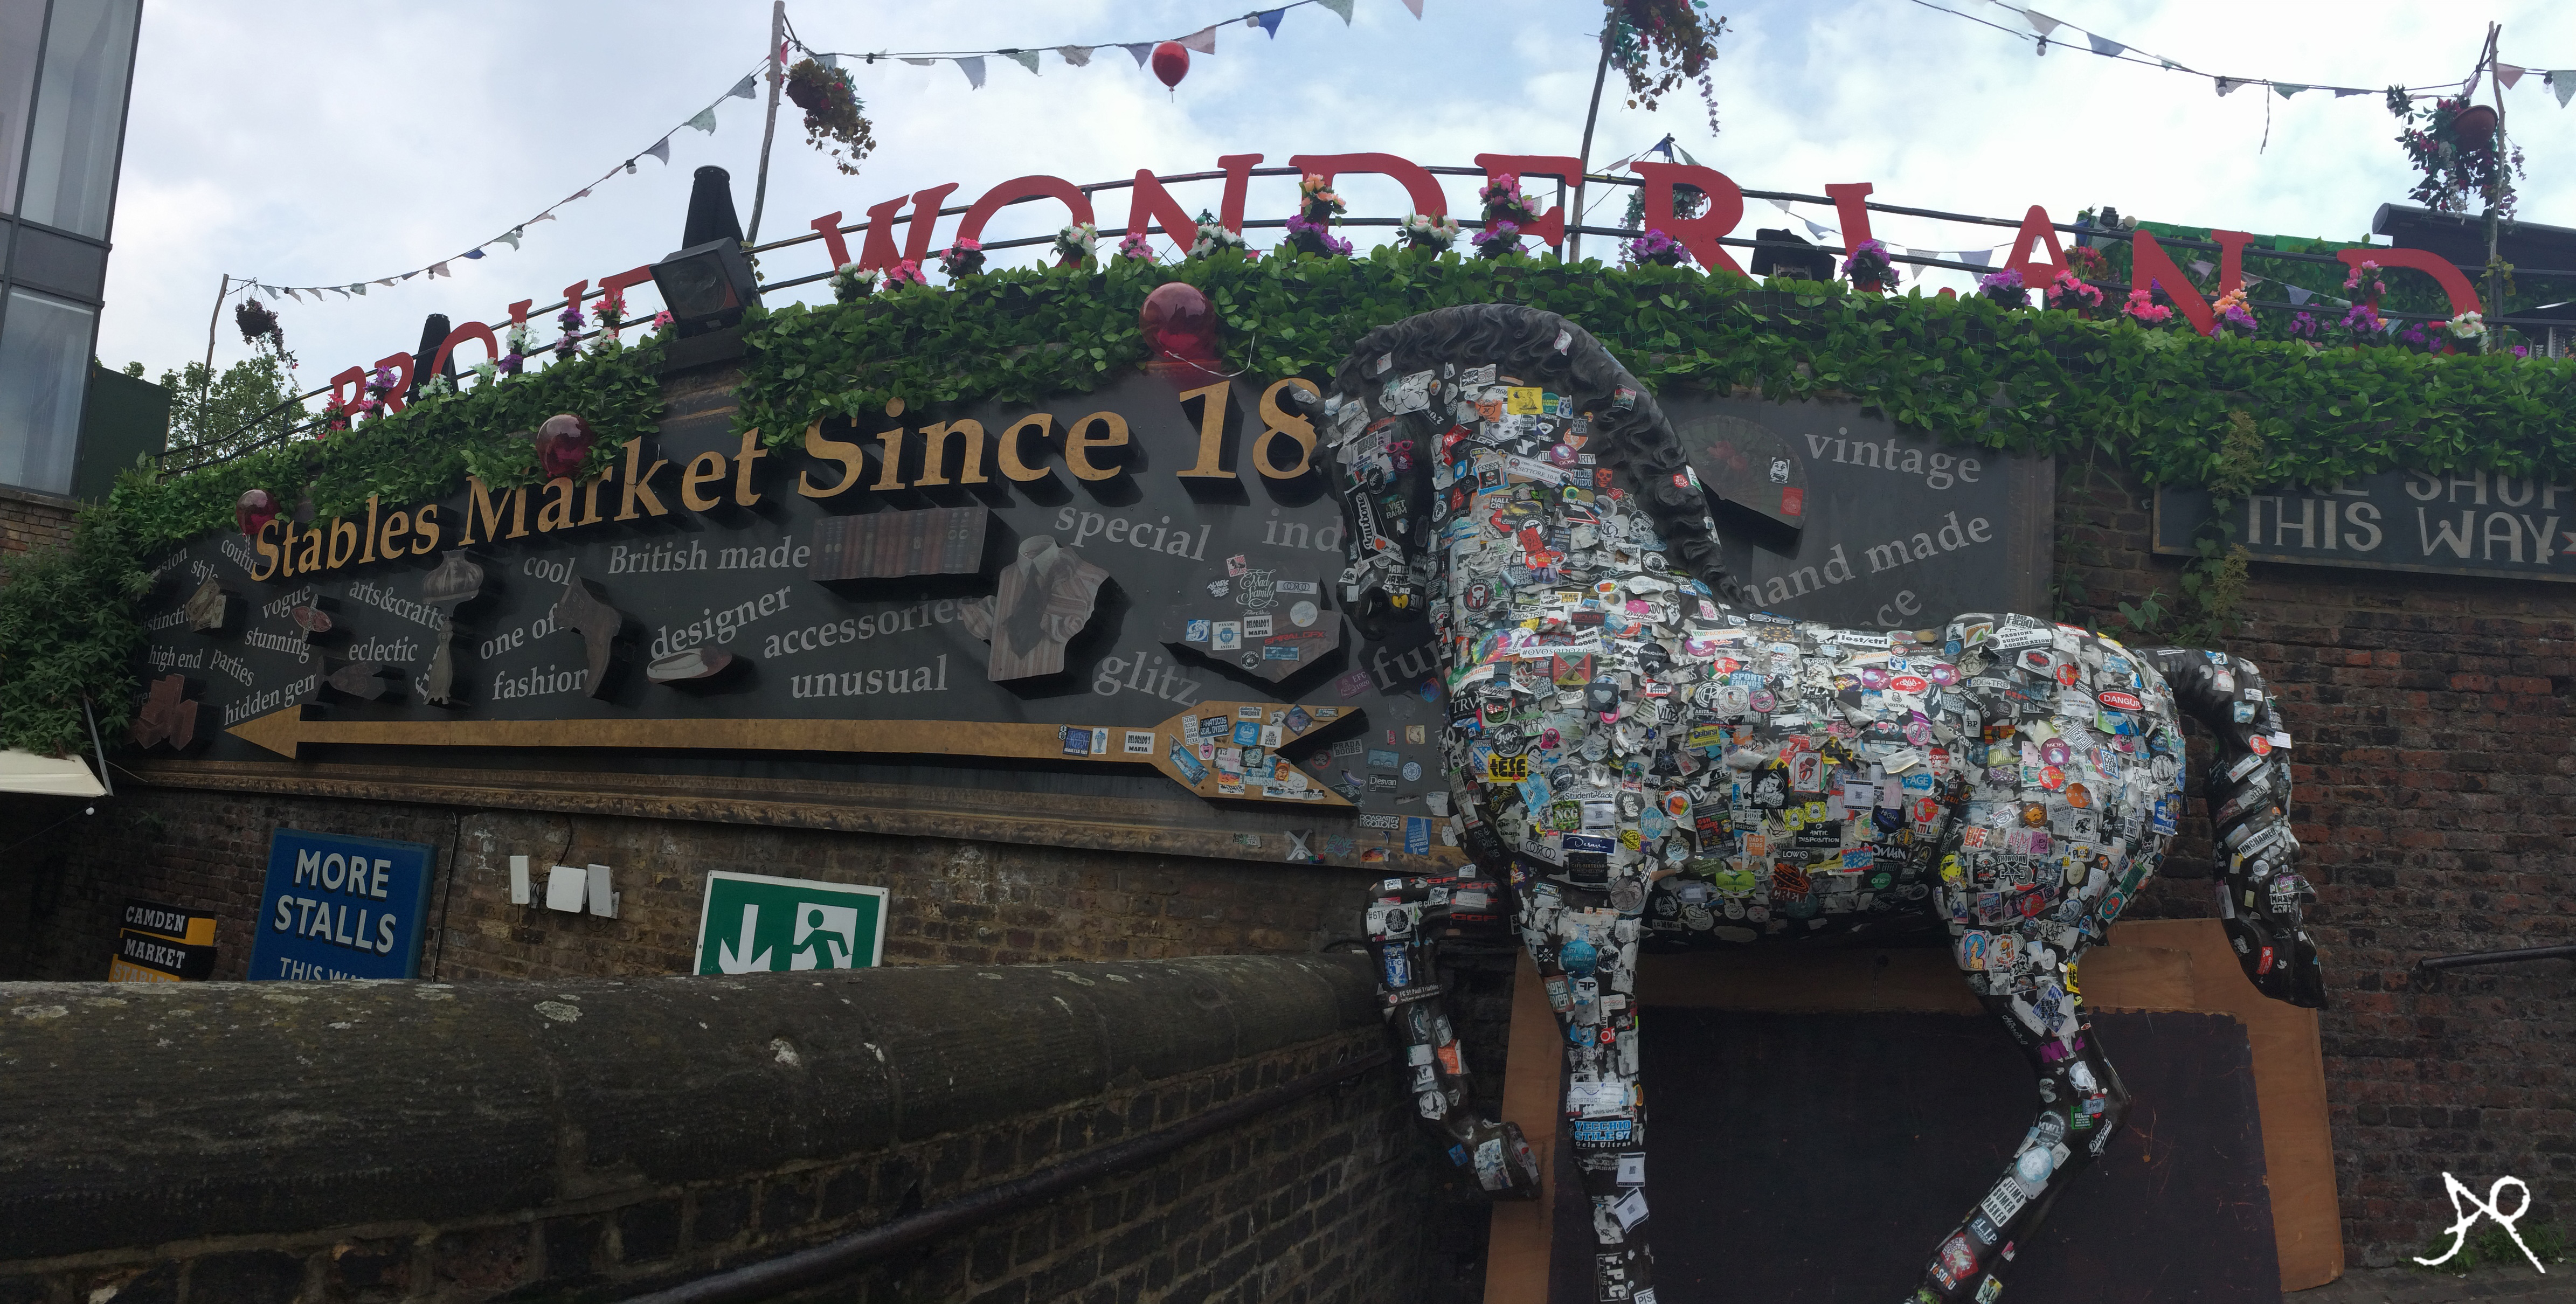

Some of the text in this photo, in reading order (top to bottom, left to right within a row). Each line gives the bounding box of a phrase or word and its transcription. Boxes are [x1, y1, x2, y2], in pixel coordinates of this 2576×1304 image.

[1805, 427, 1981, 490] vintage
[1518, 466, 1545, 478] SETTORE
[251, 493, 439, 581] Stables
[458, 427, 769, 546] Market
[798, 397, 1128, 498] Since
[1386, 508, 1408, 519] RAHM
[1388, 500, 1405, 511] VIET
[1055, 505, 1211, 561] special
[1864, 511, 1992, 573] made
[2237, 496, 2561, 565] THIS WAY
[608, 535, 811, 574] British made
[524, 557, 576, 586] cool
[262, 585, 311, 619] vogue
[650, 586, 790, 660] designer
[764, 595, 965, 658] accessories
[1246, 619, 1270, 629] BELORADO'S
[246, 627, 311, 664] stunning
[349, 636, 418, 662] eclectic
[480, 627, 524, 660] one
[1841, 636, 1888, 646] lost/ctrl
[148, 645, 204, 672] high end
[210, 649, 255, 686] parties
[791, 654, 948, 698] unusual
[1093, 651, 1202, 707] glitz
[1352, 671, 1367, 683] EFC
[1355, 679, 1370, 690] 1920
[1732, 673, 1762, 682] SPORT
[224, 689, 280, 726] hidden
[2103, 695, 2141, 708] DANGUR
[1200, 716, 1227, 727] FANATICOS
[1213, 725, 1228, 734] OVIEDO
[1127, 734, 1151, 745] BELORADO'S
[1333, 740, 1361, 749] PRADA
[1335, 746, 1361, 755] BOOBS
[2103, 752, 2114, 761] SCH
[1369, 775, 1397, 786] Desvan
[2105, 765, 2116, 775] ERA
[1565, 790, 1614, 800] StudentHack
[1555, 808, 1578, 820] NCG
[1881, 809, 1897, 822] HIGH
[1917, 823, 1940, 836] MLH
[2127, 826, 2136, 836] SHIT
[2240, 826, 2277, 854] UNCHAINED
[1998, 854, 2027, 864] SHOWDOWN
[295, 849, 391, 898] MORE
[126, 905, 186, 932] CAMDEN
[275, 894, 397, 953] STALLS
[124, 939, 185, 969] MARKET
[1575, 1120, 1631, 1130] VECCHIO
[1575, 1130, 1631, 1141] STILE 87
[1993, 1188, 2016, 1214] SUMER
[2003, 1180, 2025, 1204] JEIMS
[1983, 1197, 2007, 1225] PASKER
